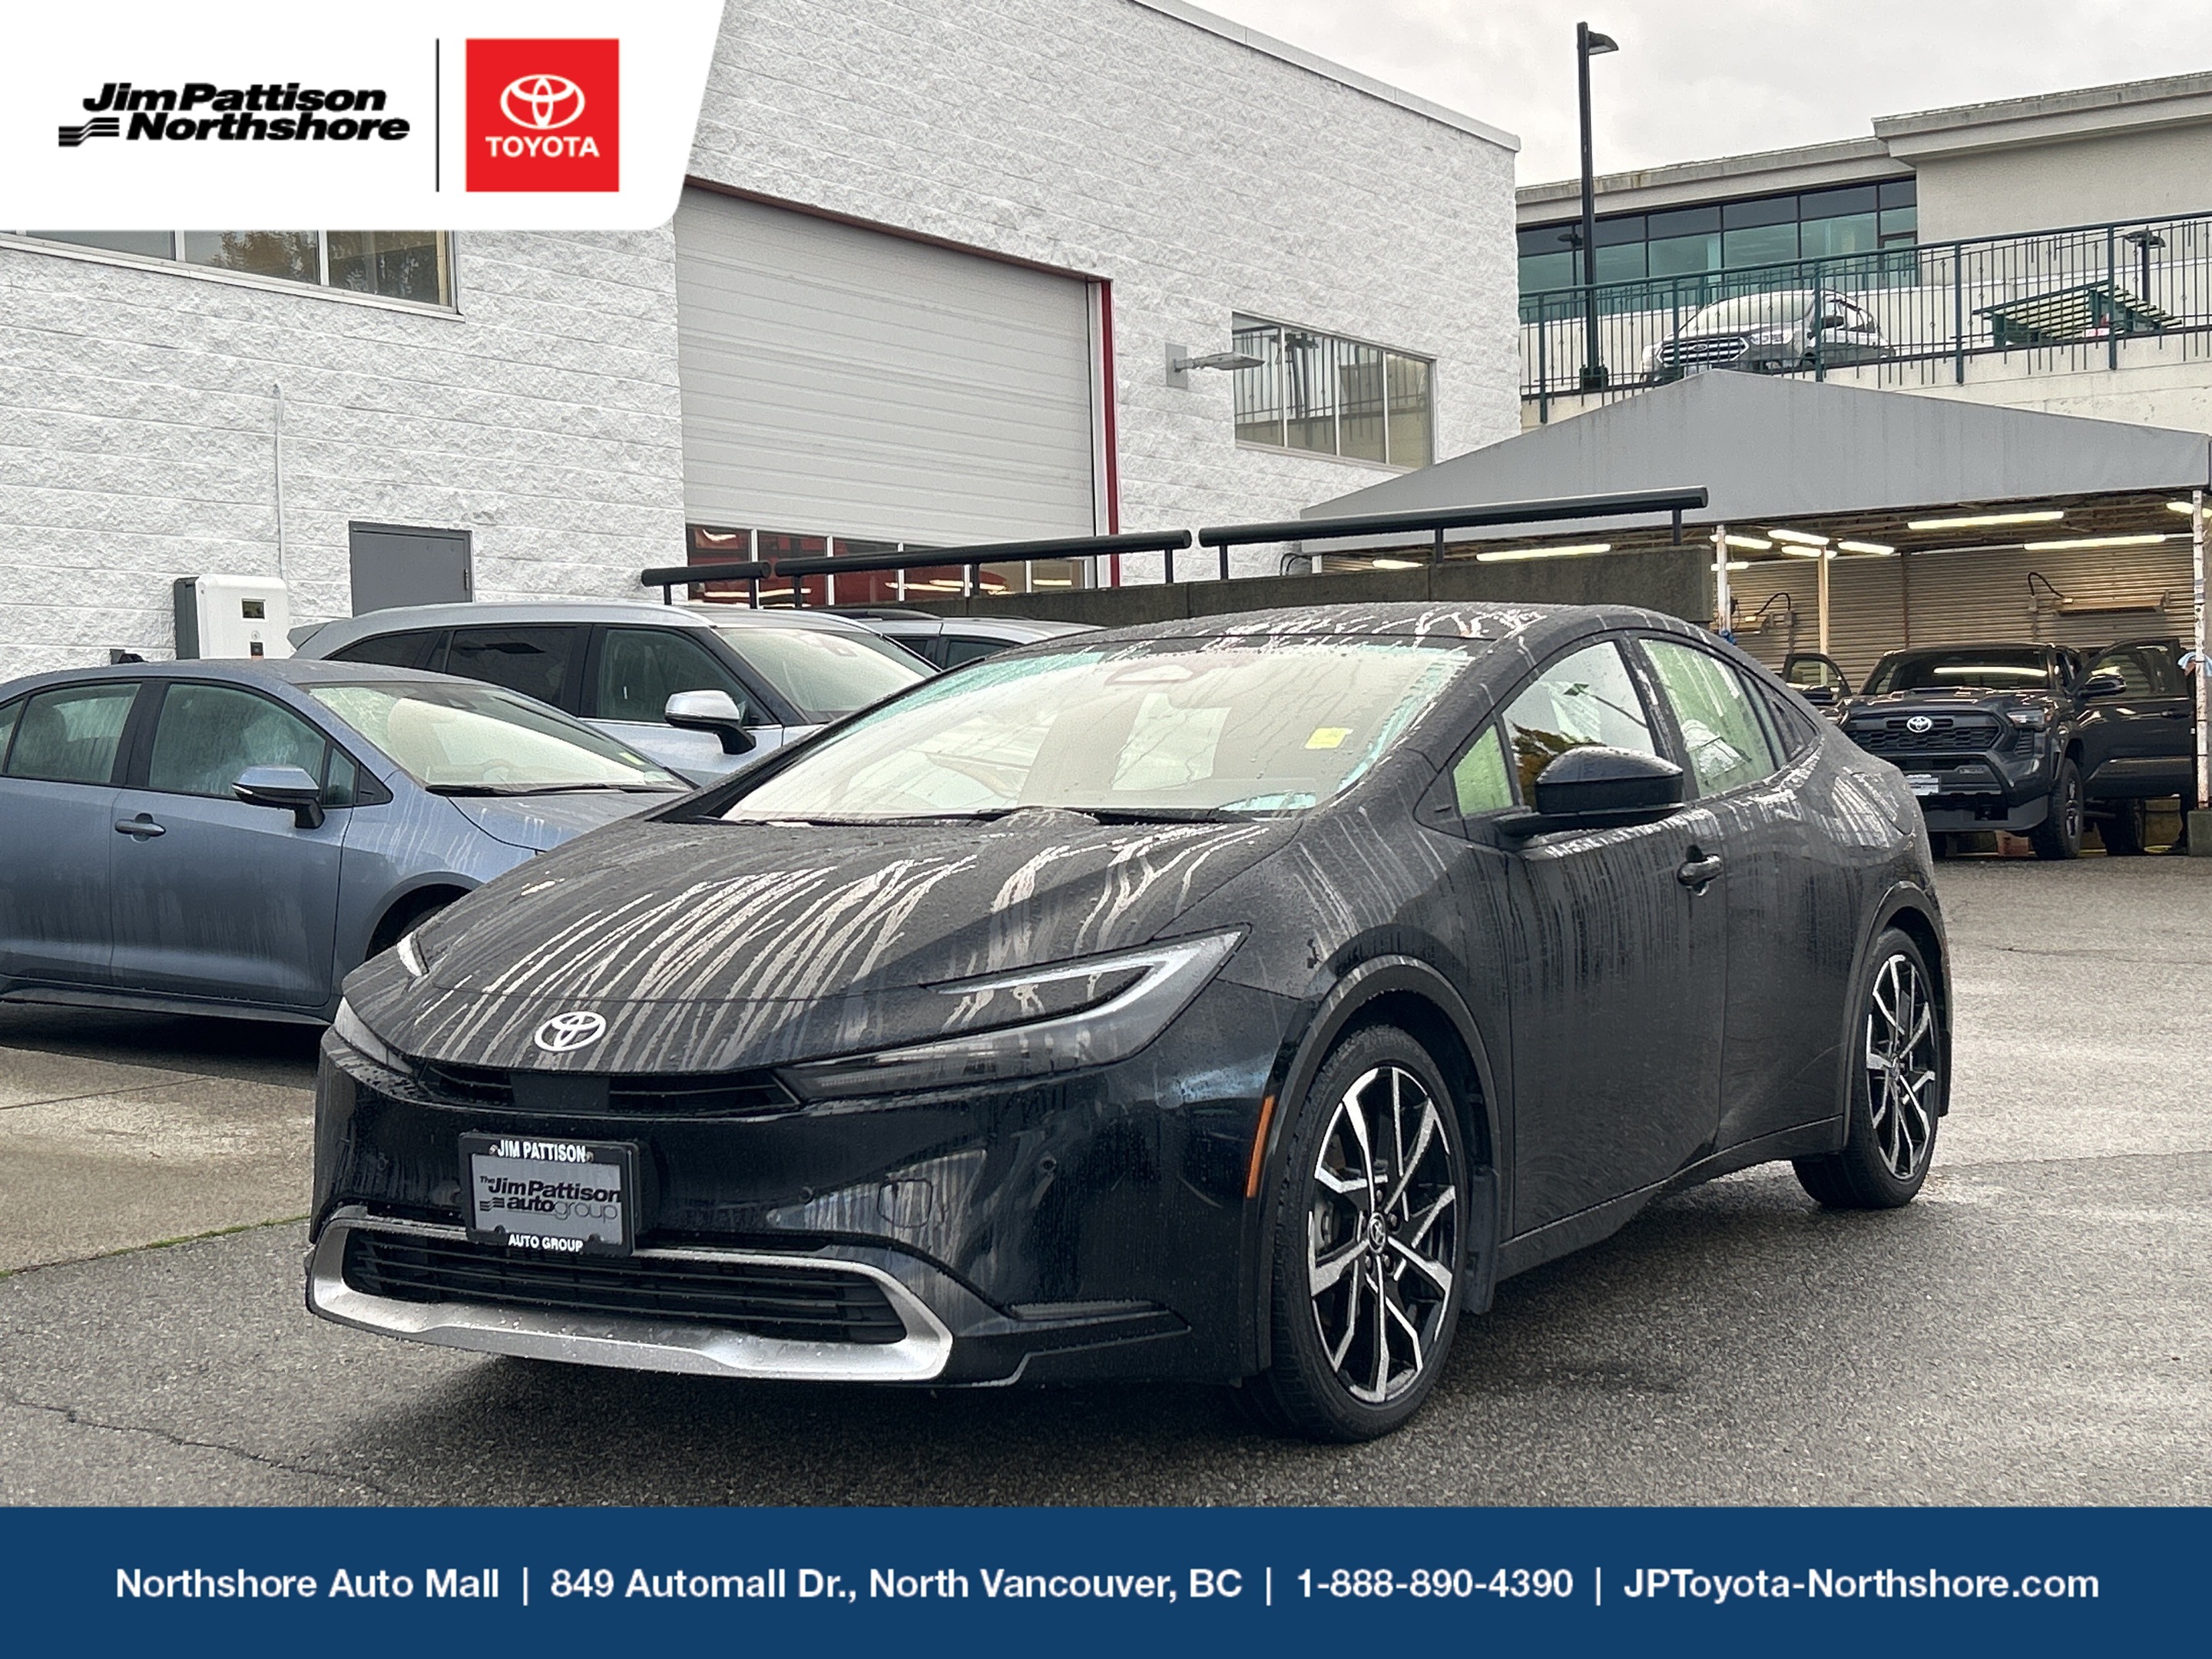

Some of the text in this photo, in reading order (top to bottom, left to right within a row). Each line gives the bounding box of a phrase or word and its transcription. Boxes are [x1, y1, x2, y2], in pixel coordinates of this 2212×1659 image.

[498, 1140, 586, 1162] JIM PATTISON
[479, 1176, 495, 1184] The
[488, 1177, 622, 1203] Jim Pattison
[508, 1234, 584, 1252] AUTO GROUP
